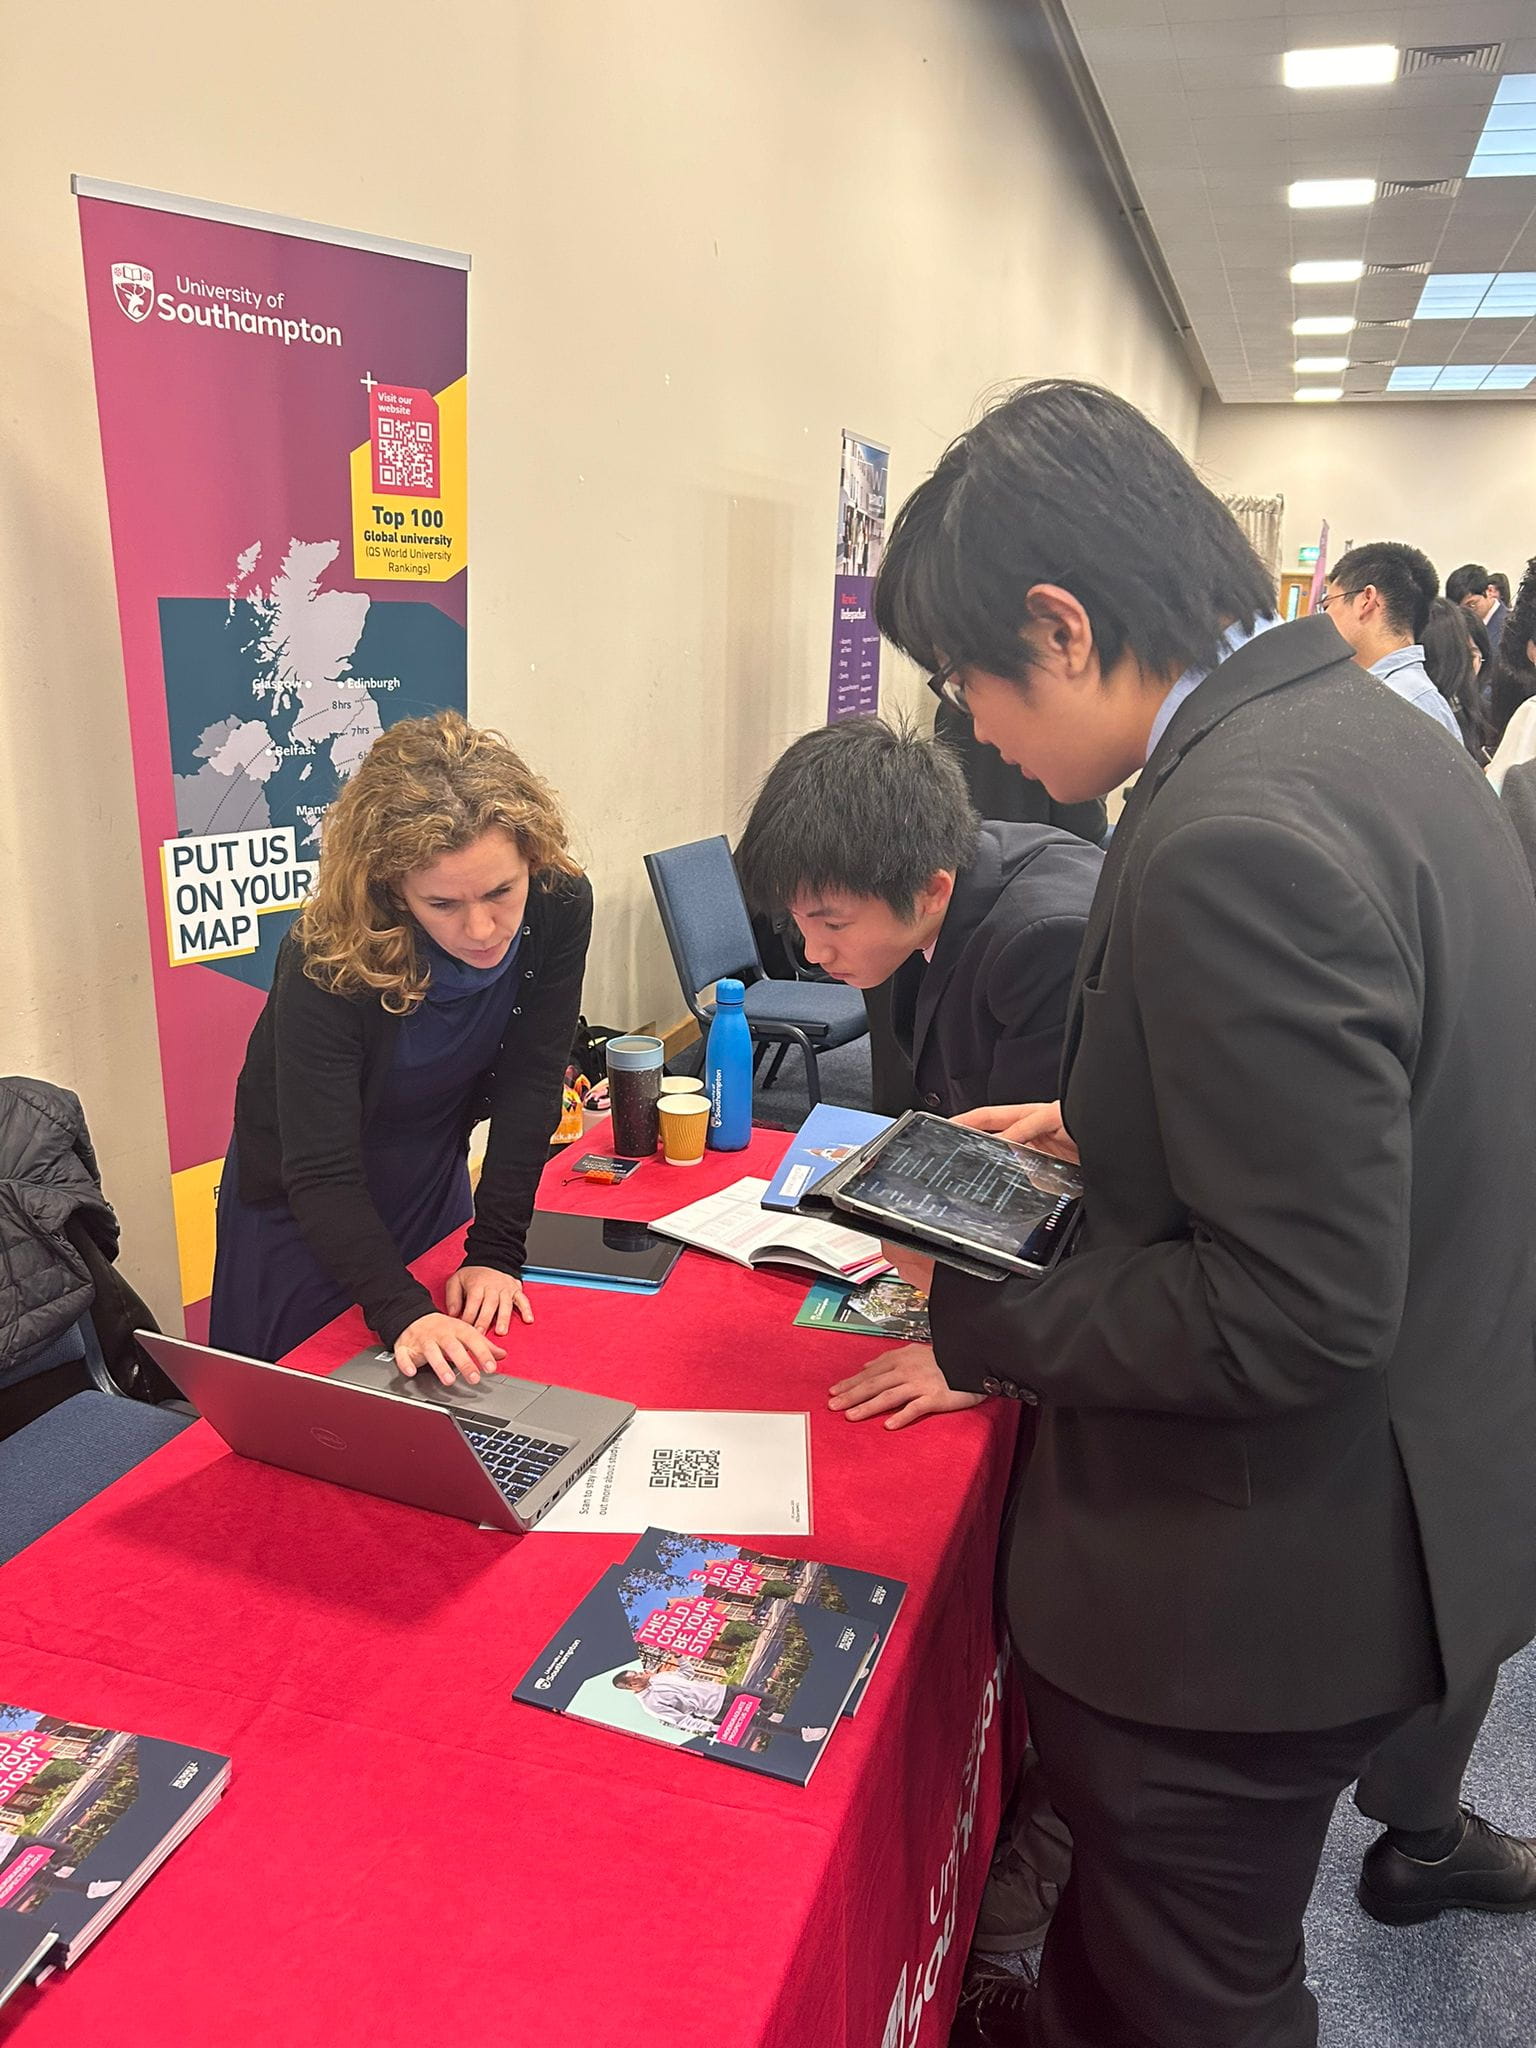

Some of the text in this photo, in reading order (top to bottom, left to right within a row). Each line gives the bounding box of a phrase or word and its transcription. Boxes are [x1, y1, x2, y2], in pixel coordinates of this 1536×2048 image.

[176, 275, 285, 310] University of
[156, 293, 342, 347] Southampton
[377, 392, 413, 406] Visit our
[377, 404, 412, 416] website
[372, 506, 444, 530] Top 100
[364, 530, 453, 548] Global university
[365, 545, 452, 562] (QS World University
[388, 562, 431, 575] Rankings)
[252, 677, 401, 692] Glasgow Edinburgh
[275, 745, 316, 756] Belfast
[173, 834, 289, 878] PUT US
[176, 869, 313, 916] ON YOUR
[179, 915, 252, 954] MAP
[715, 1069, 723, 1118] Southampton
[585, 1474, 598, 1489] stay
[603, 1464, 616, 1484] about
[583, 1489, 593, 1498] to
[602, 1484, 612, 1503] more
[579, 1498, 591, 1515] Scan
[599, 1503, 609, 1516] out
[722, 1561, 749, 1590] YOUR
[639, 1613, 668, 1640] THIS
[656, 1605, 691, 1645] COULD
[671, 1632, 694, 1650] BE
[683, 1600, 713, 1632] YOUR
[688, 1614, 721, 1655] STORY
[546, 1639, 582, 1682] Southampton
